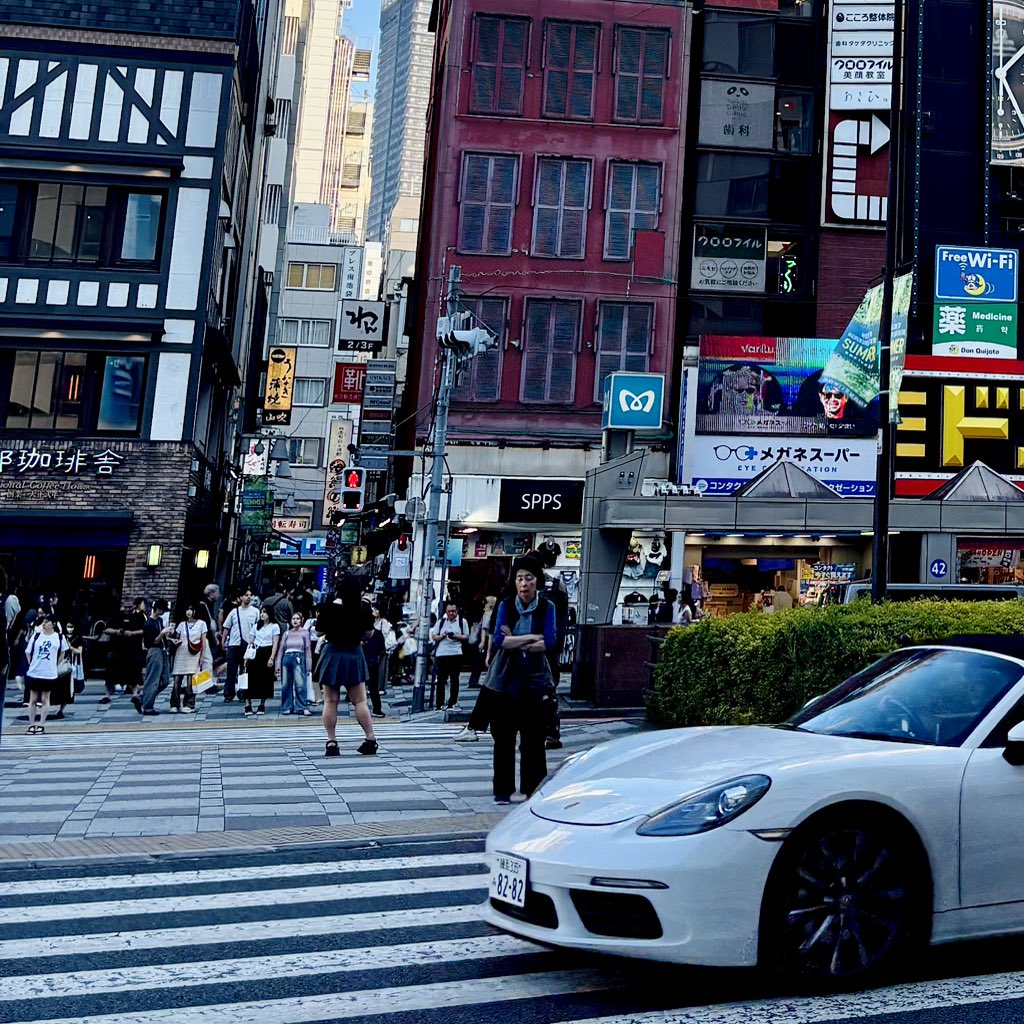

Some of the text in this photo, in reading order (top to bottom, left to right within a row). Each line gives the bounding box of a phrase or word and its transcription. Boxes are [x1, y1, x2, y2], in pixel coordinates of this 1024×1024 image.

[846, 12, 895, 22] こころ整体院
[723, 124, 750, 136] 歯科
[942, 250, 1013, 270] Free Wi-Fi
[939, 306, 967, 335] 薬
[972, 311, 1013, 322] Medicine
[961, 347, 974, 355] Don
[265, 413, 288, 424] 山吹
[760, 446, 860, 463] メガネスーパー
[521, 494, 562, 510] SPPS
[931, 561, 947, 575] 42
